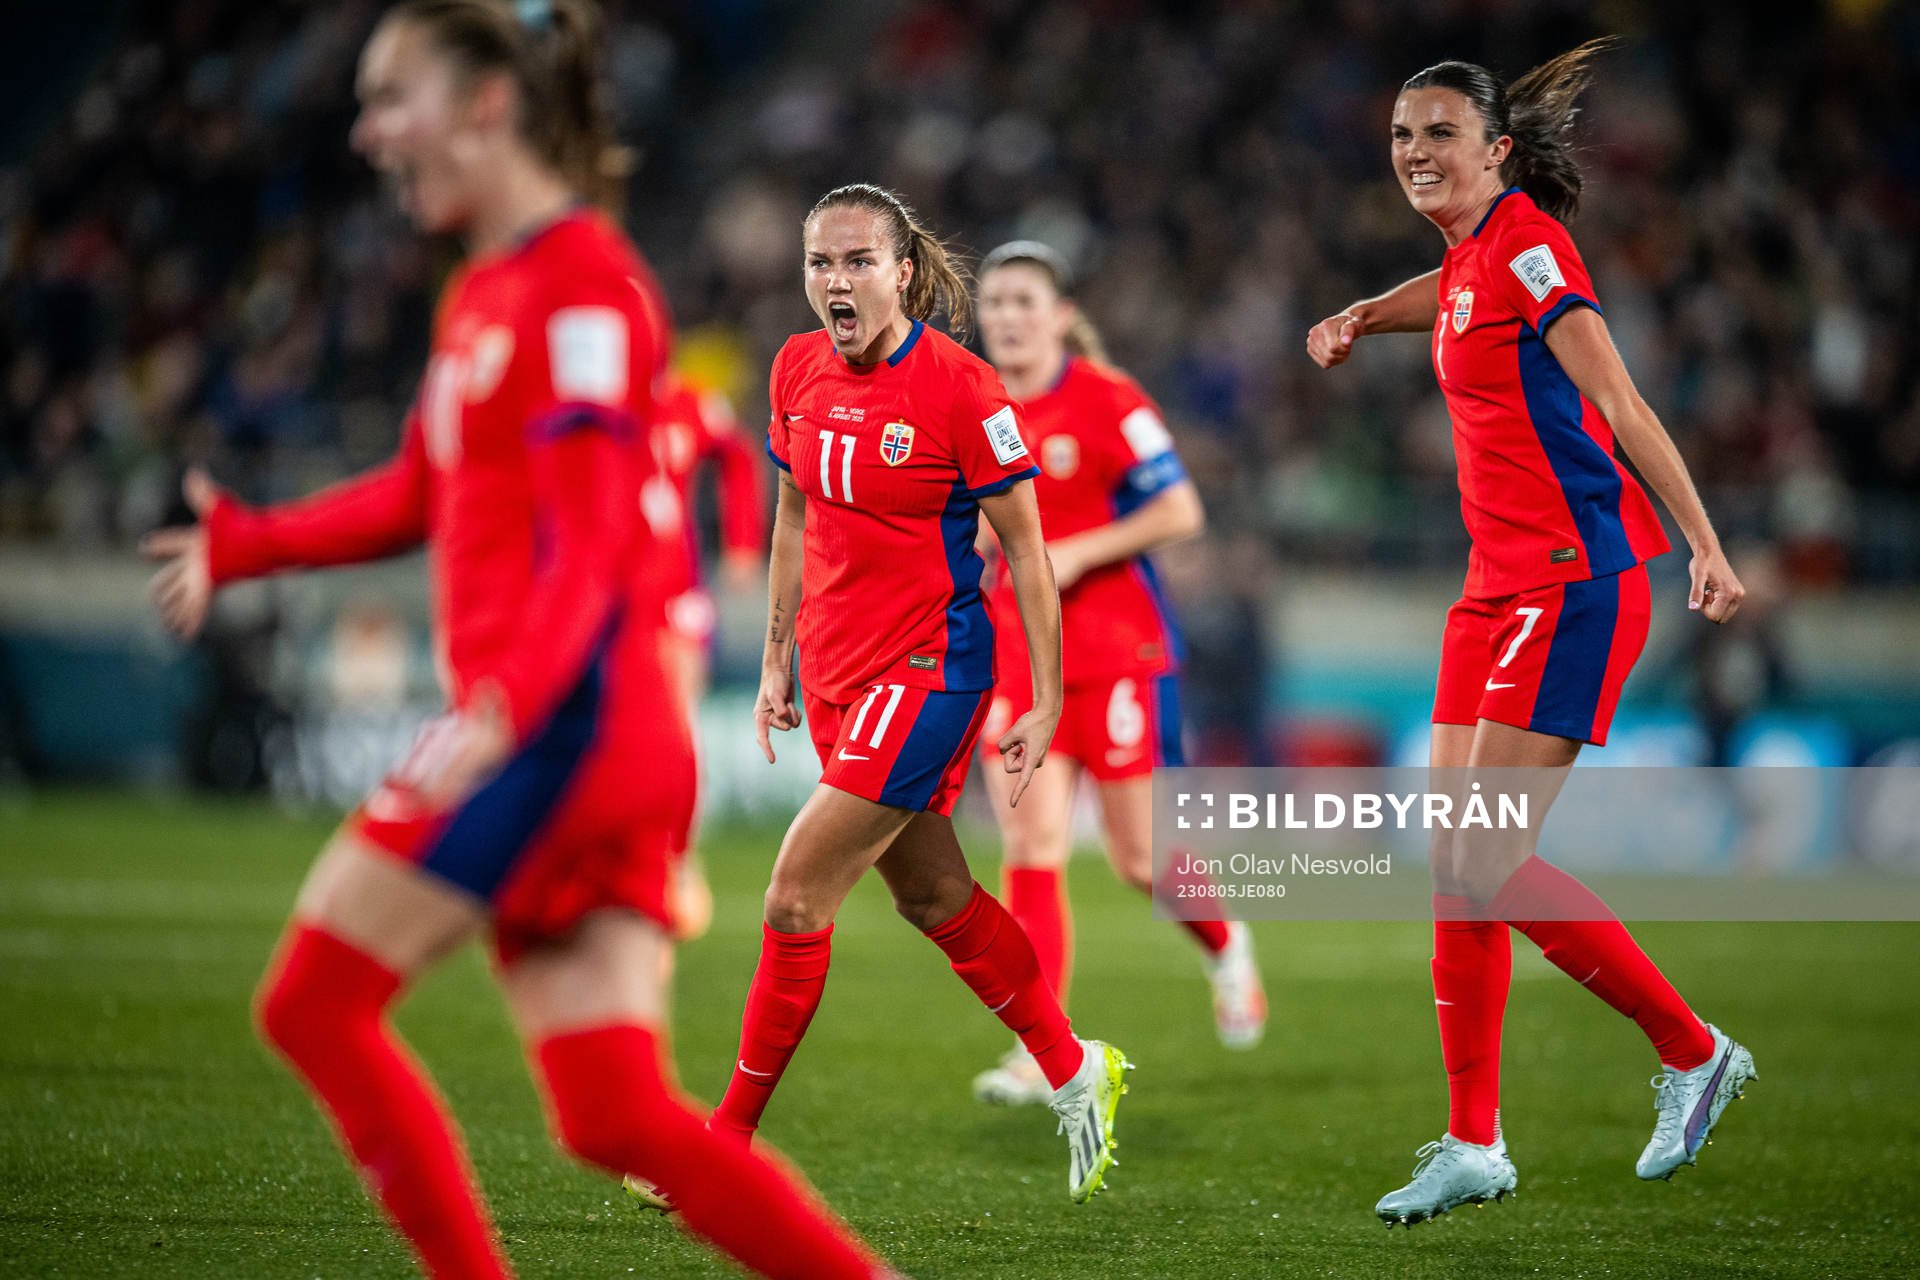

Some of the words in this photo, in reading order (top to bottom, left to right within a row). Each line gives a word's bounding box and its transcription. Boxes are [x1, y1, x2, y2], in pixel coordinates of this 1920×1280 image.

[1523, 258, 1547, 277] UNITES
[832, 413, 851, 421] AUGUST
[819, 430, 857, 504] 11
[1498, 607, 1544, 668] 7
[849, 684, 906, 750] 11
[1106, 677, 1146, 747] 6
